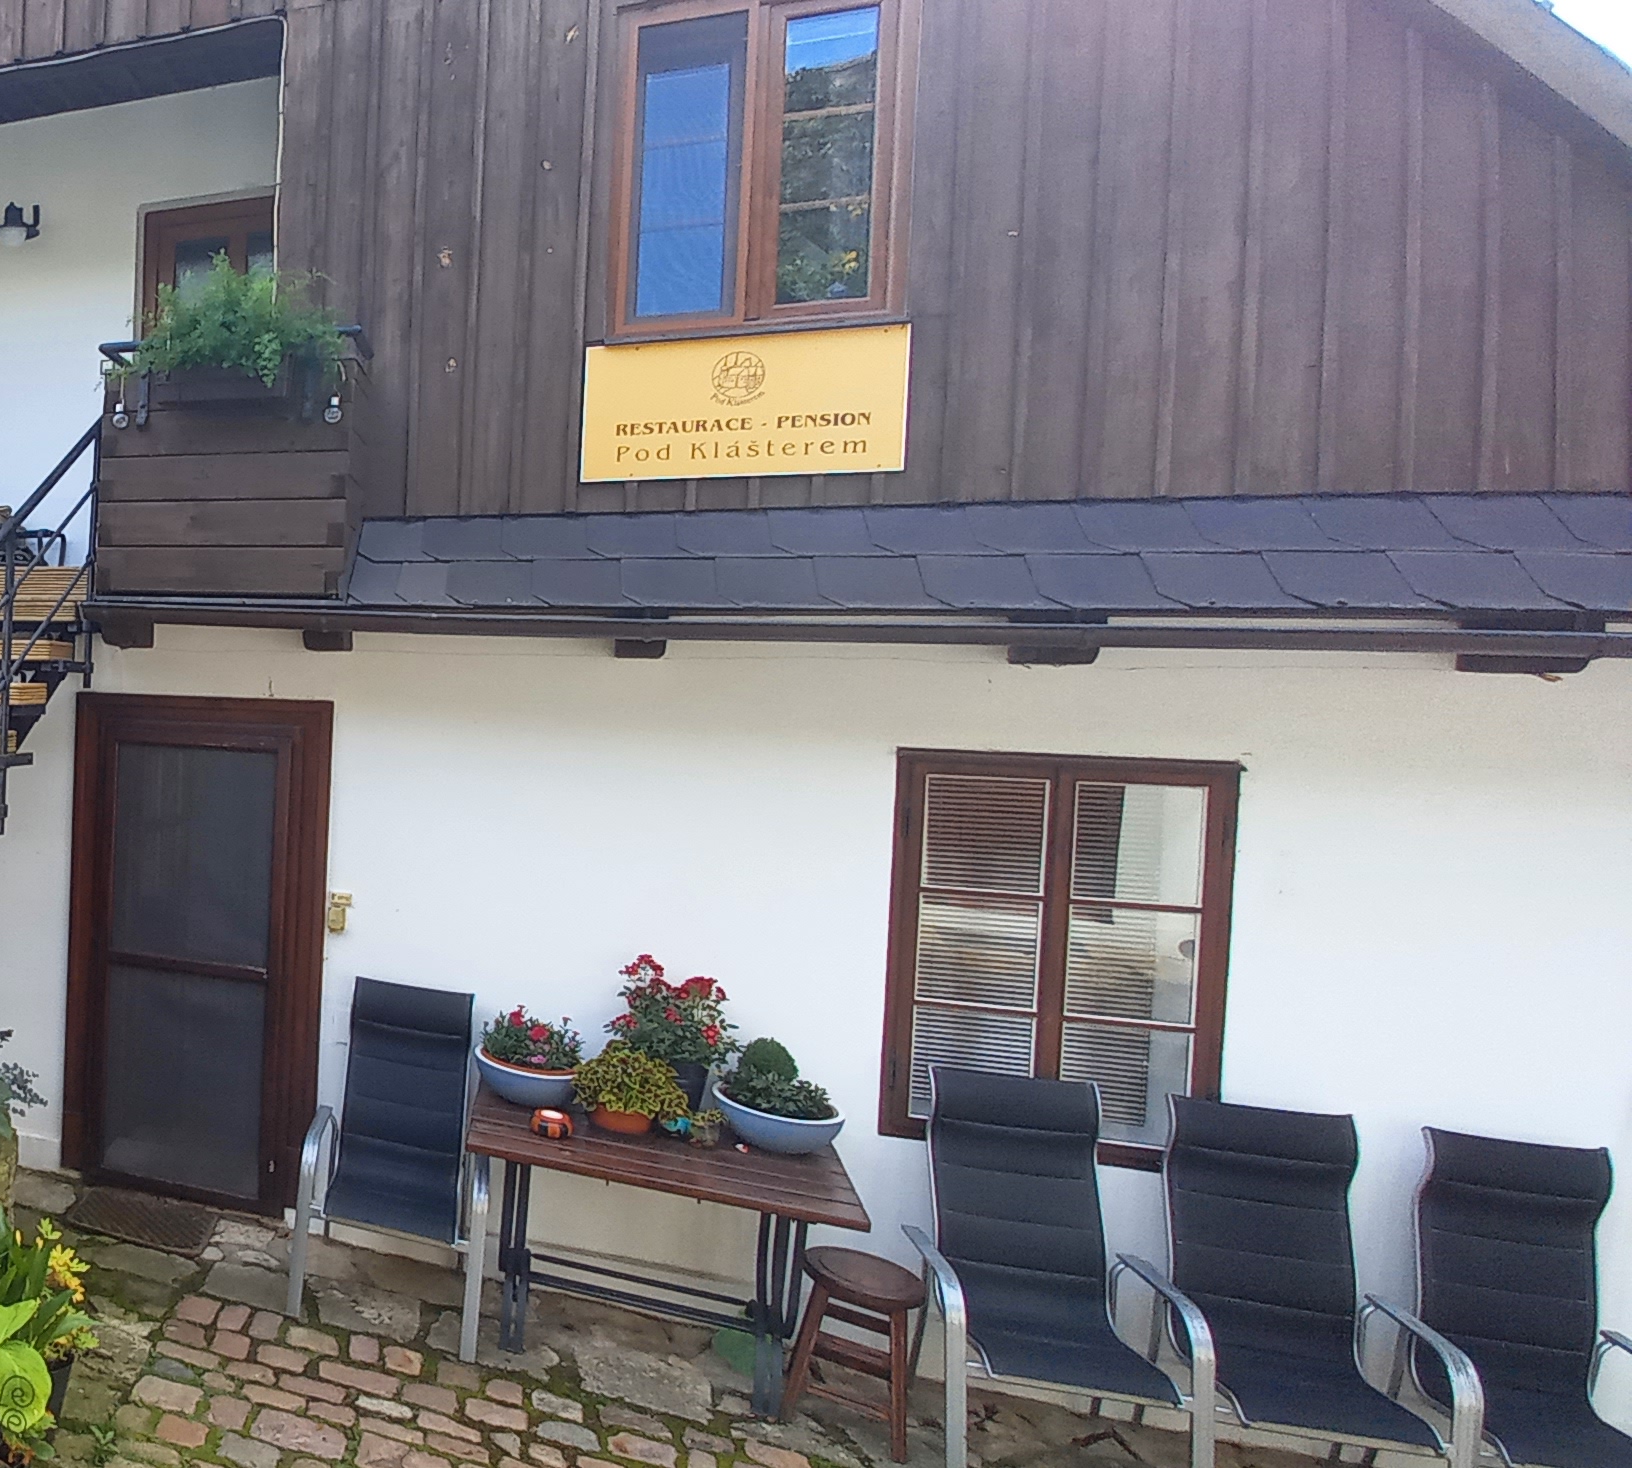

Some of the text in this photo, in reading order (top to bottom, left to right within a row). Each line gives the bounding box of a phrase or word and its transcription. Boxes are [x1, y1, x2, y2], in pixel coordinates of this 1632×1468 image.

[615, 416, 753, 436] RESTAURACE
[776, 411, 872, 428] PENSION
[616, 437, 868, 463] Pod Klášterem
